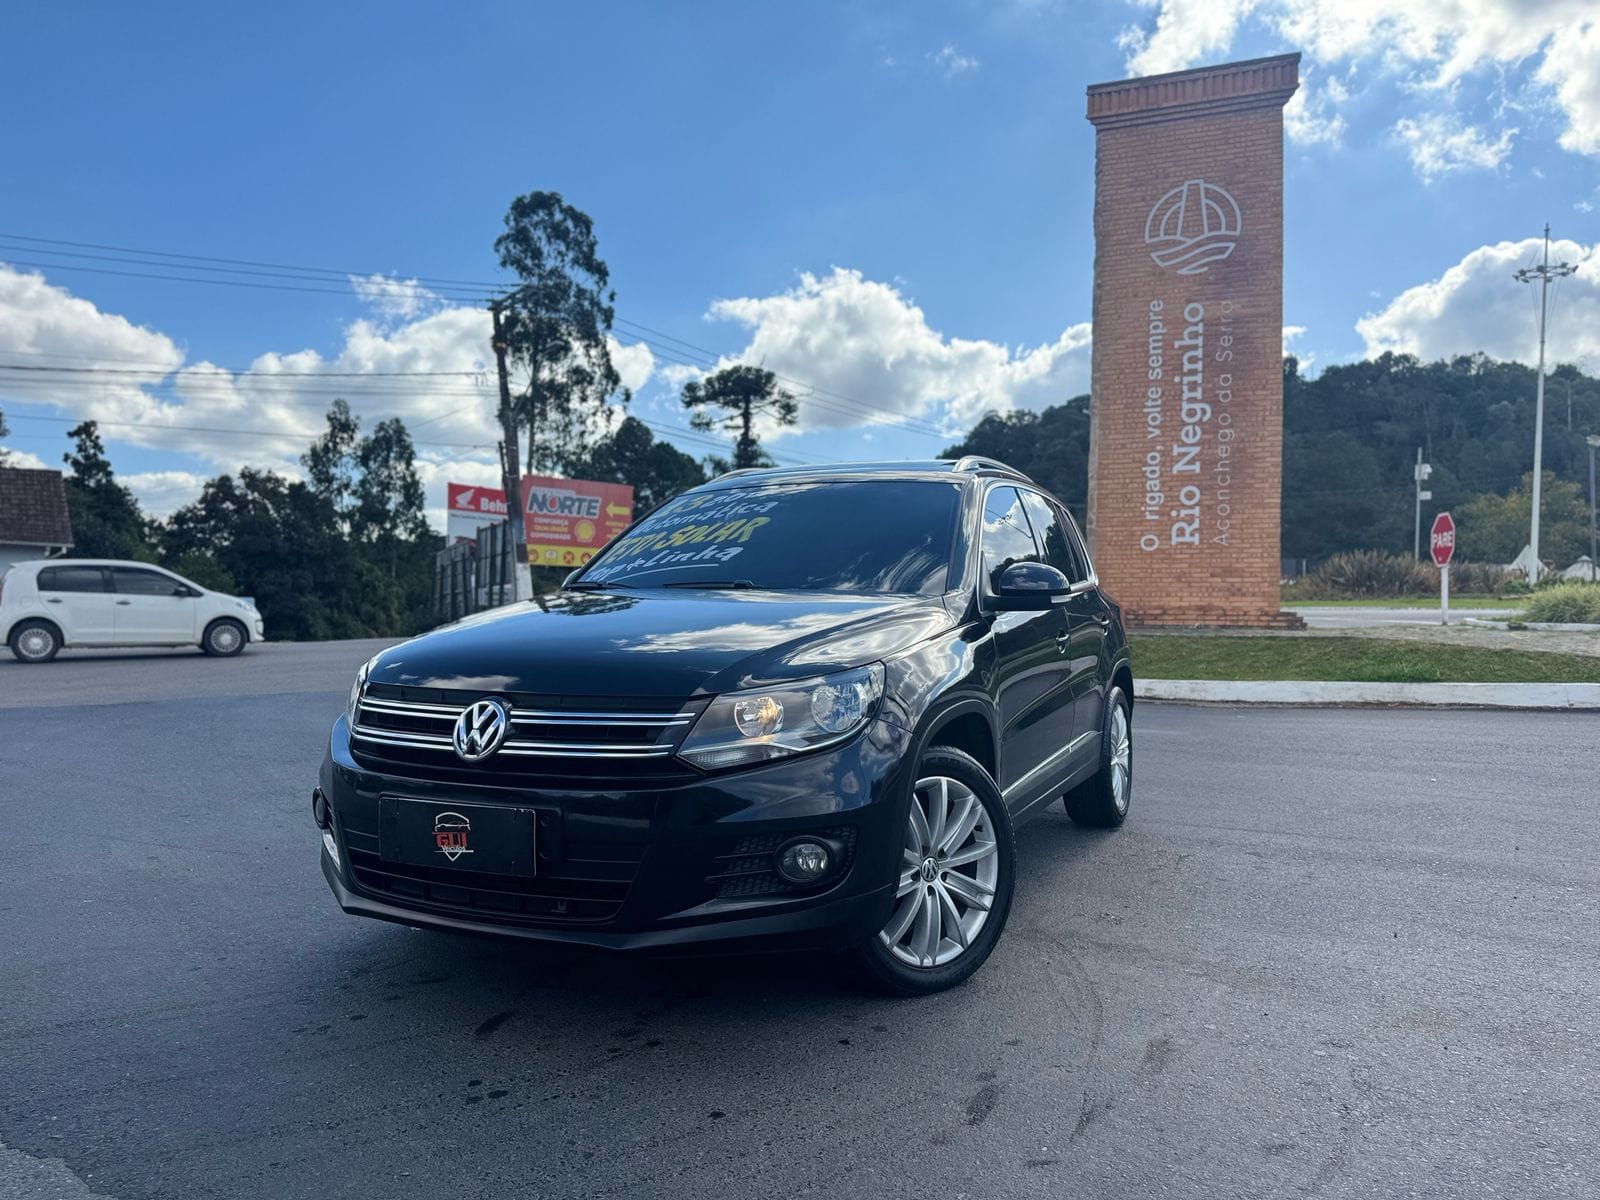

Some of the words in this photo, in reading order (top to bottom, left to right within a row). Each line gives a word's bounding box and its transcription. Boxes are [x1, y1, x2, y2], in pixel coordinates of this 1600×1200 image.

[1146, 299, 1167, 380] sempre
[1215, 300, 1233, 362] Serra
[1143, 386, 1162, 439] volte
[1172, 302, 1211, 474] Negrinho
[1217, 373, 1233, 403] da
[528, 493, 601, 516] NORTE
[1213, 413, 1235, 546] Aconchego
[651, 517, 771, 551] SOLAR
[1171, 485, 1200, 546] Rio
[1432, 531, 1453, 548] PARE
